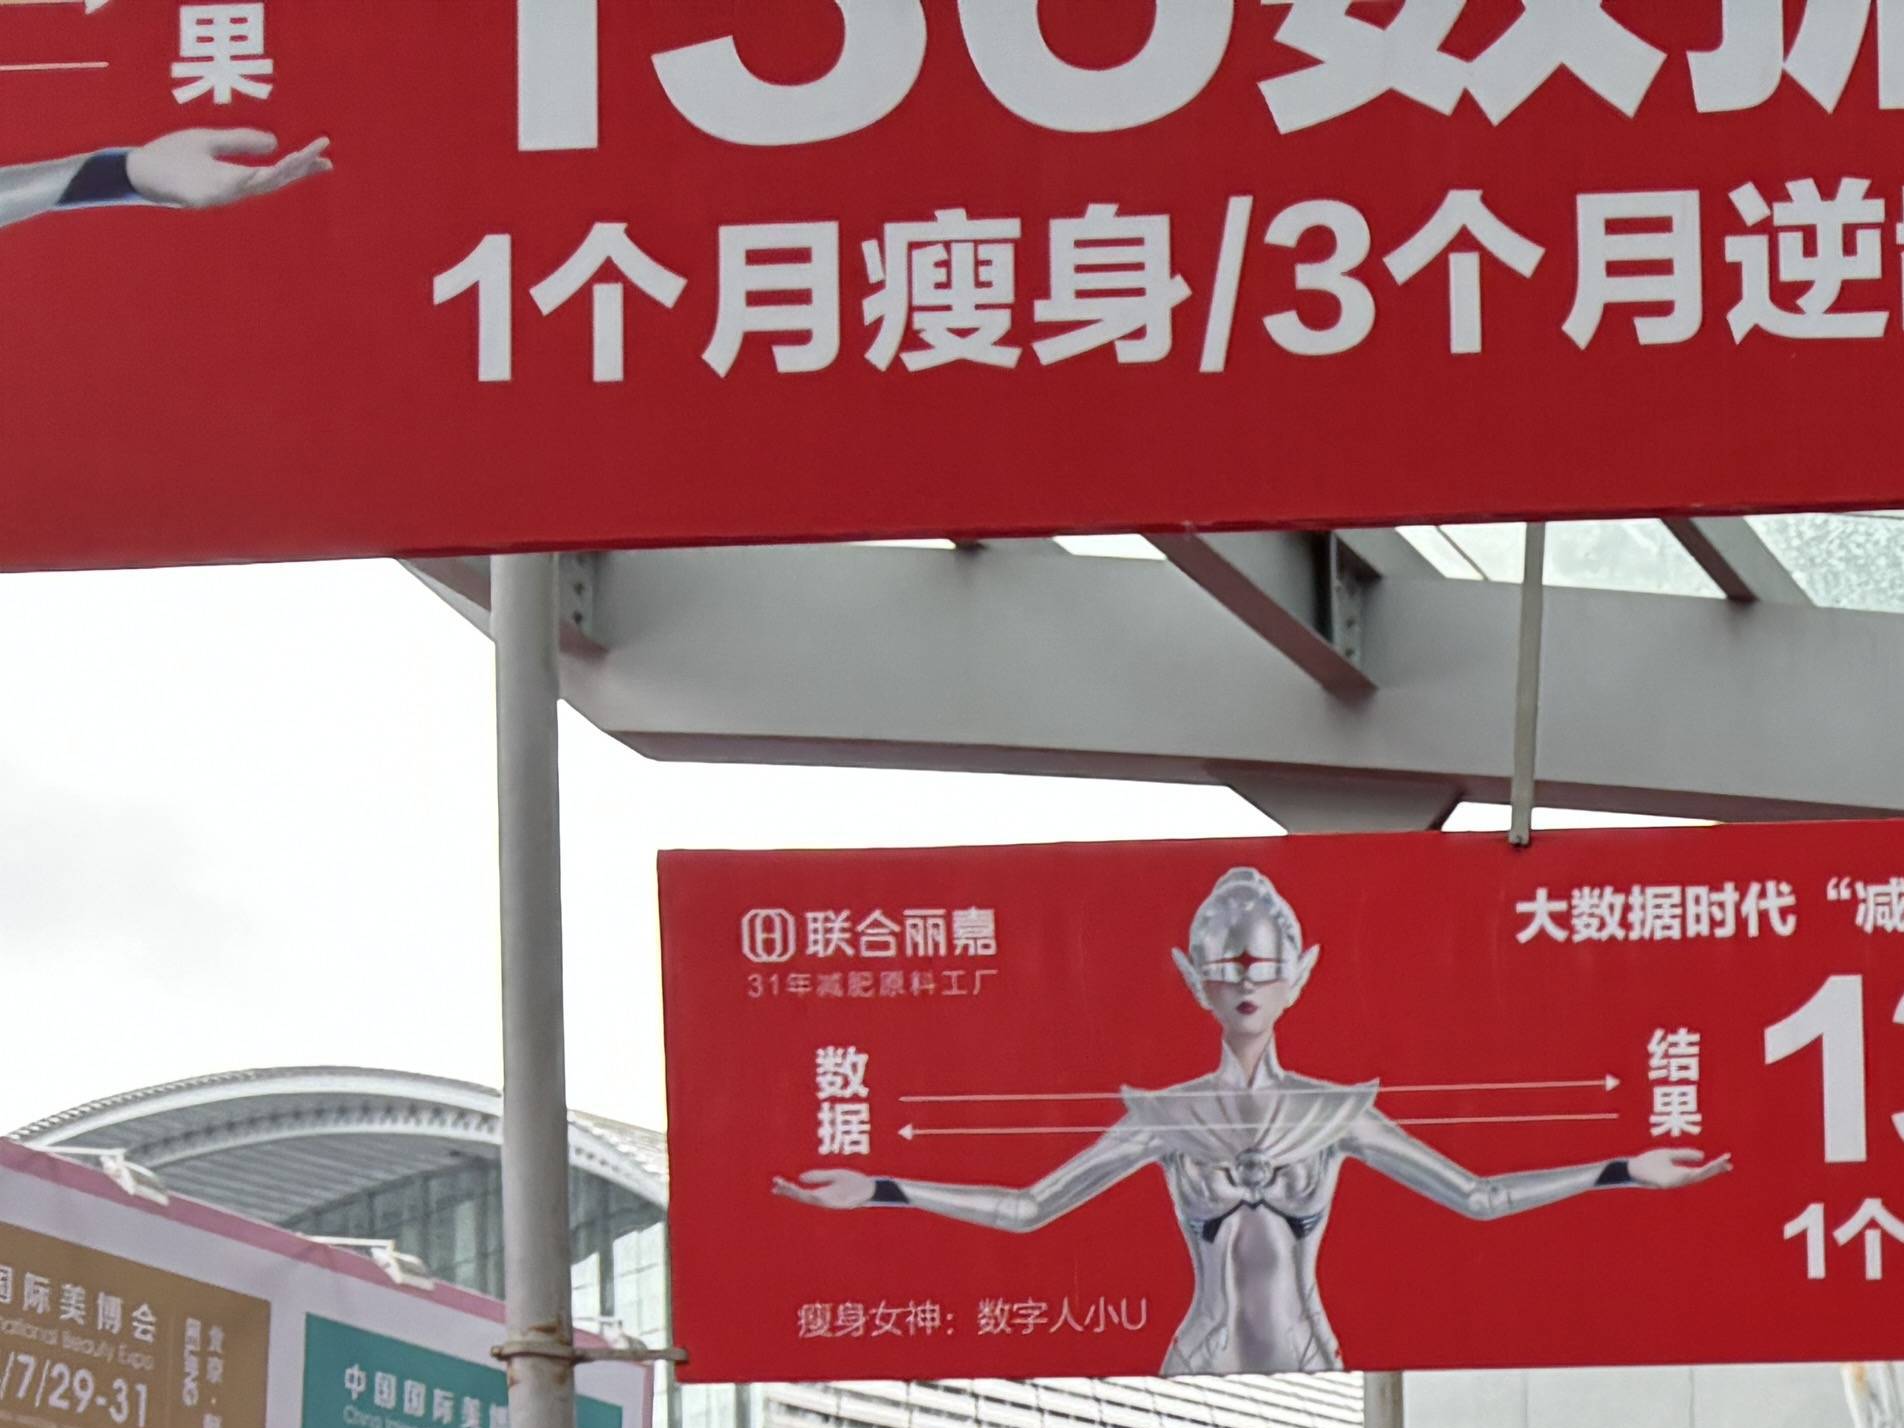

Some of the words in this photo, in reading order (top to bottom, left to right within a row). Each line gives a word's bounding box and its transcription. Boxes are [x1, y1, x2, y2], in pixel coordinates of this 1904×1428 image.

[805, 906, 997, 959] 联合丽嘉
[747, 969, 998, 998] 31年减肥原料工厂
[816, 1046, 870, 1155] 数据
[1647, 1028, 1702, 1138] 结果
